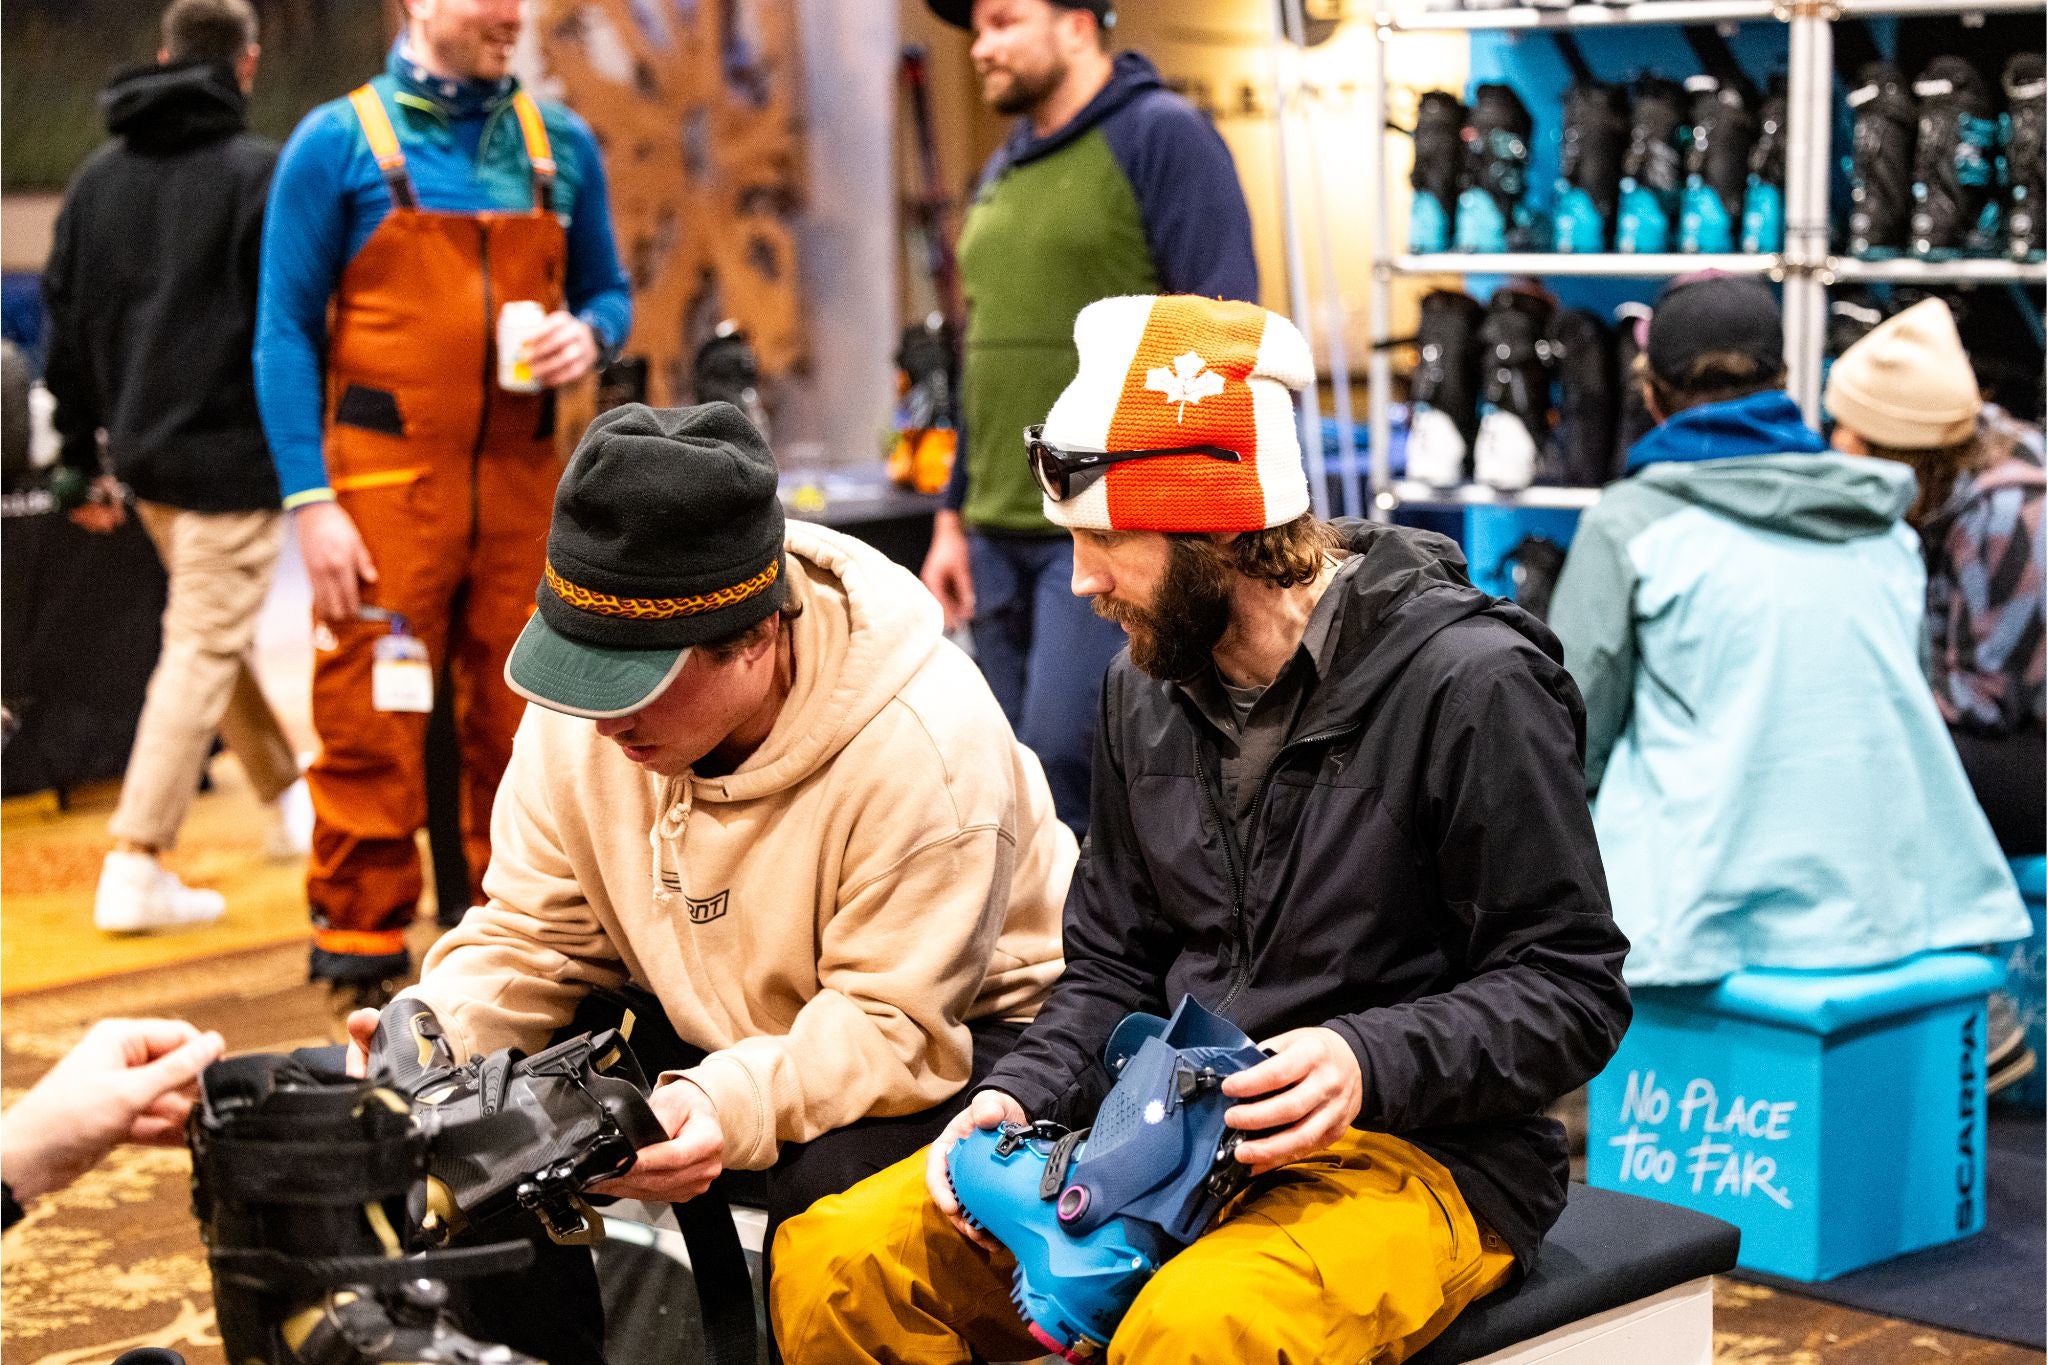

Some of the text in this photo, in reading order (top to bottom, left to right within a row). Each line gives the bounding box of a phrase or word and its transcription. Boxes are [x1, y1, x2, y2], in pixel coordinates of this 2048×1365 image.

[1620, 1070, 1797, 1140] NO PLACE
[1956, 1012, 1977, 1231] SCARPA
[1608, 1125, 1677, 1183] TOO
